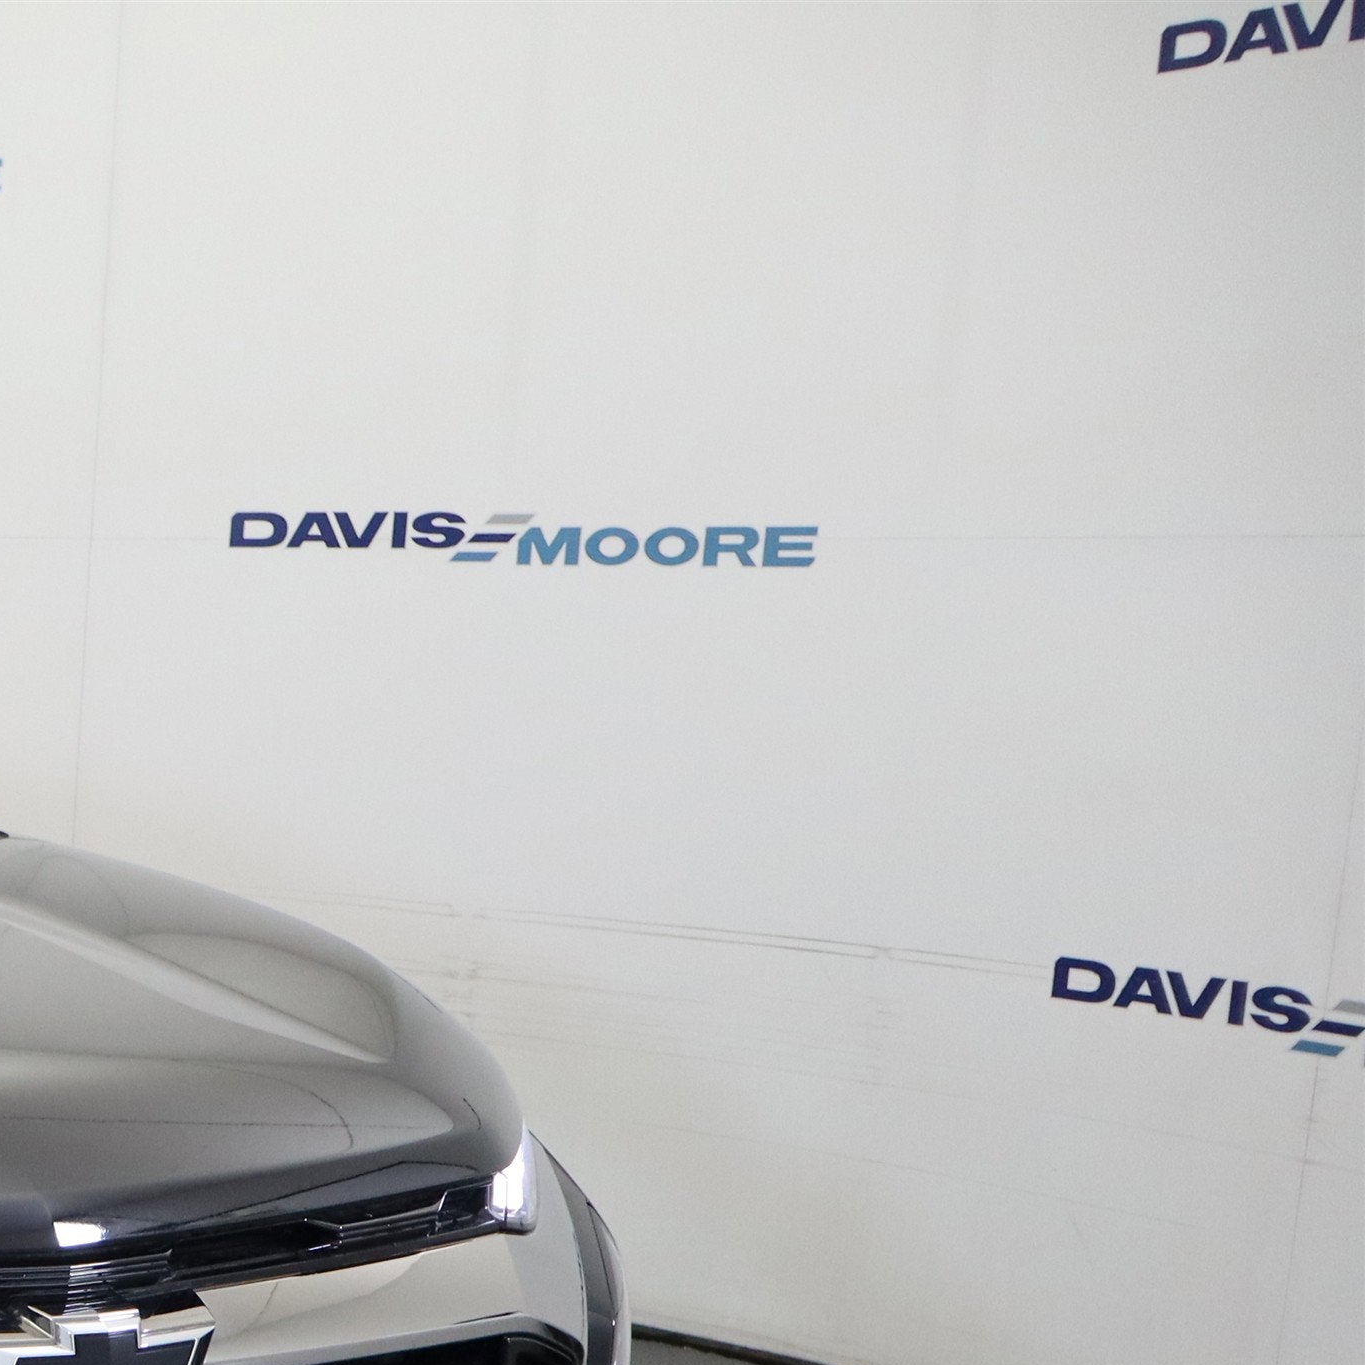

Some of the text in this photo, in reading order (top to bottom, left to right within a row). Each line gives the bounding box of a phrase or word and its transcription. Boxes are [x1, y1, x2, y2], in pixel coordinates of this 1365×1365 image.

[229, 511, 818, 567] DAVIS MOORE
[1051, 956, 1312, 1033] DAVIS
